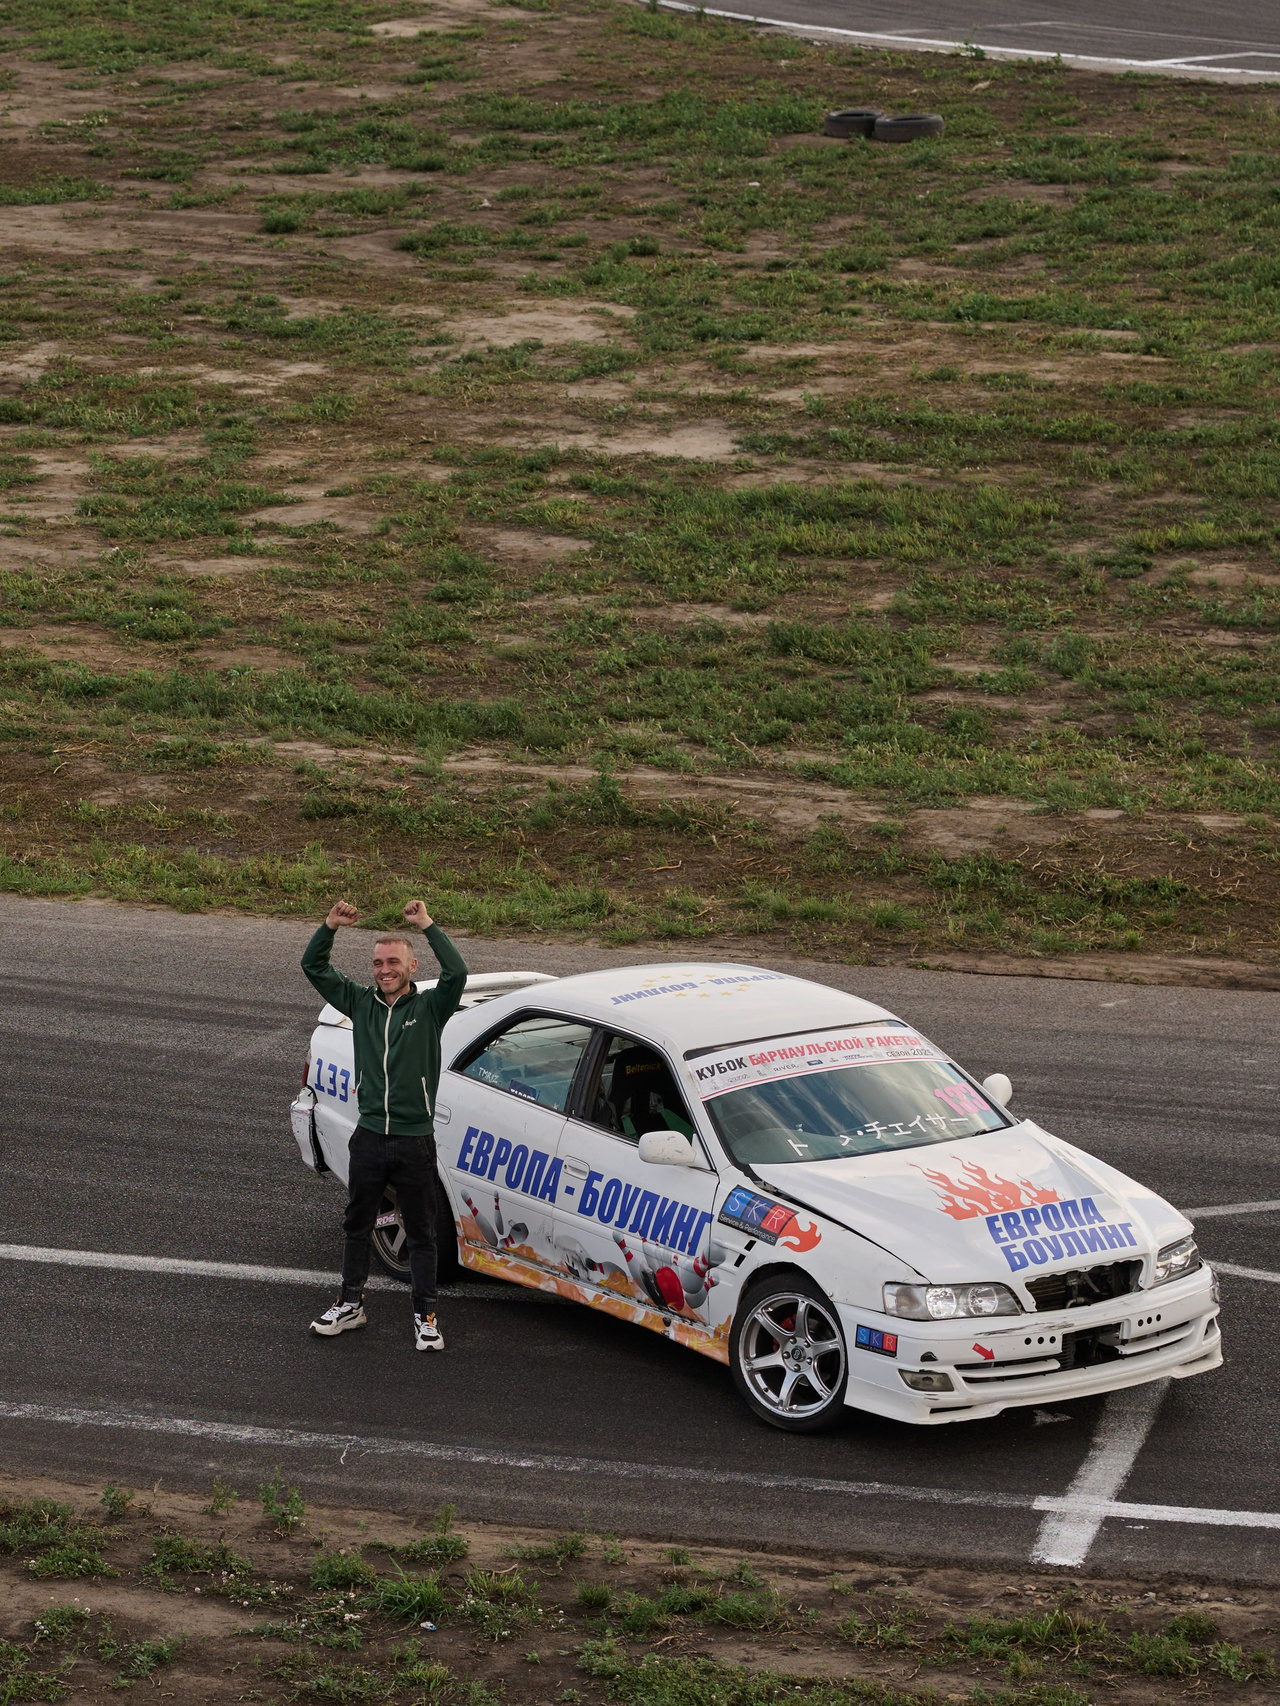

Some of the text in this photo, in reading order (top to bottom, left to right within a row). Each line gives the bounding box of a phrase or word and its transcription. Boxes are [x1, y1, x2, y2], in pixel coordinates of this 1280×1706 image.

[610, 982, 699, 1005] БОУЛИНГ
[708, 974, 786, 985] ЕВРОПА
[696, 1057, 748, 1081] КУБОК
[748, 1036, 864, 1066] БАРНАУЛЬСКОЙ
[865, 1035, 923, 1048] РАКЕТЫ
[886, 1048, 934, 1058] СЕЗОН 2025
[314, 1058, 350, 1103] 133
[933, 1082, 990, 1116] 133
[456, 1126, 564, 1204] ЕВРОПА
[577, 1170, 714, 1256] БОУЛИНГ
[720, 1213, 739, 1228] Service
[728, 1192, 786, 1230] SKR
[985, 1197, 1106, 1244] ЕВРОПА
[1000, 1222, 1138, 1272] БОУЛИНГ
[859, 1328, 894, 1350] SKR
